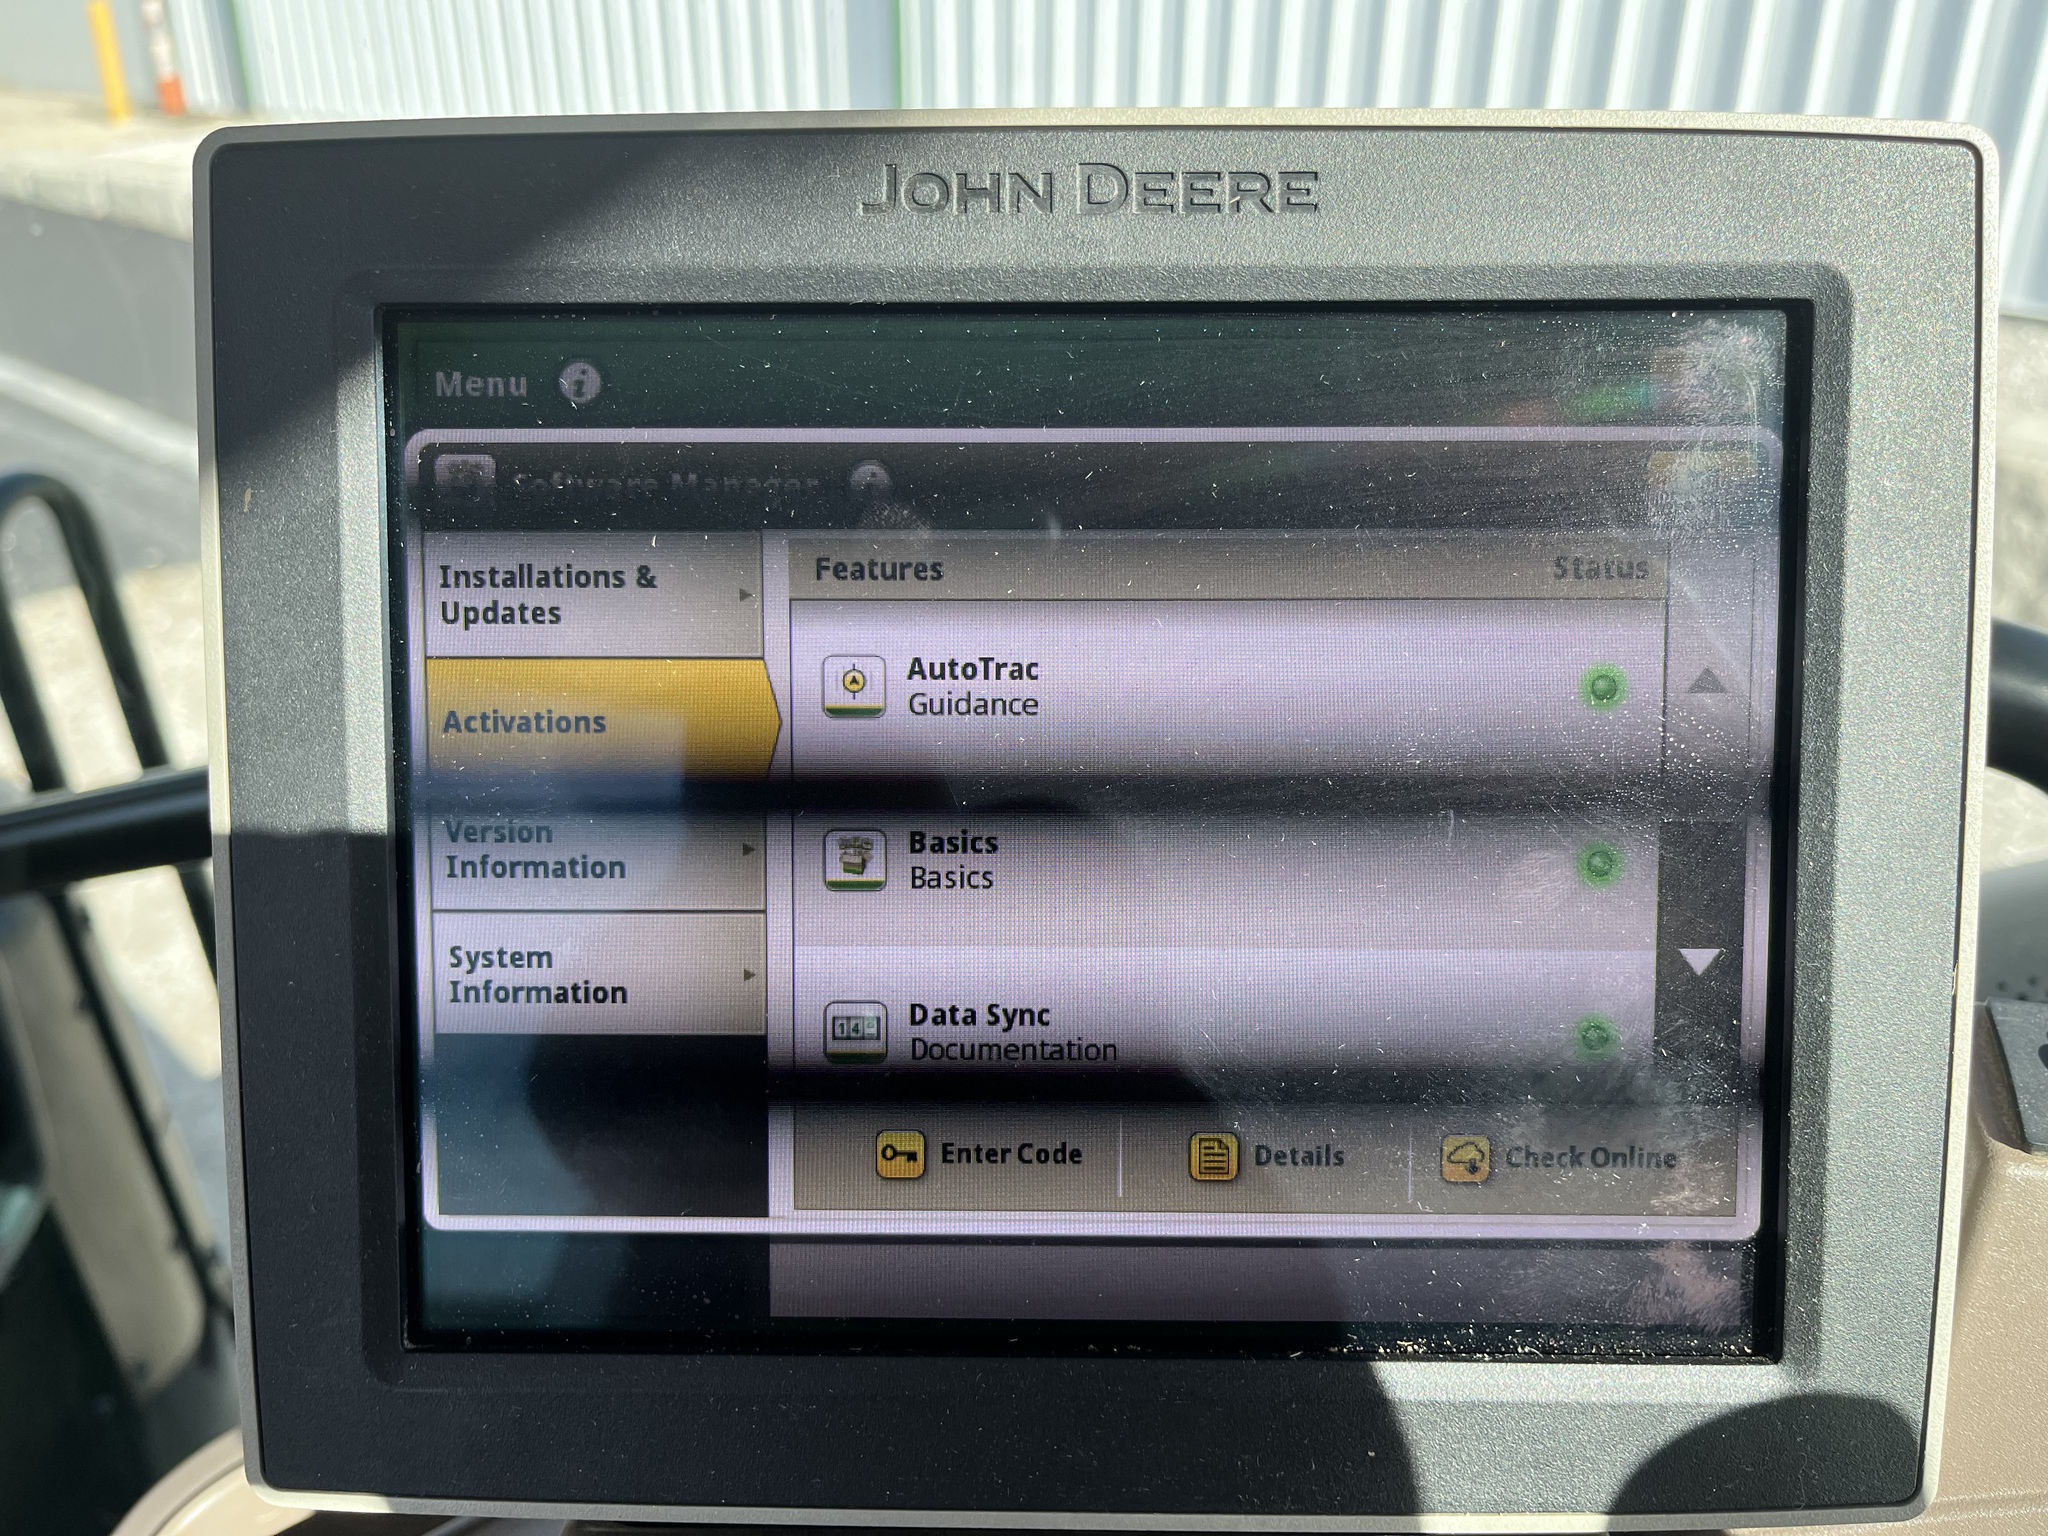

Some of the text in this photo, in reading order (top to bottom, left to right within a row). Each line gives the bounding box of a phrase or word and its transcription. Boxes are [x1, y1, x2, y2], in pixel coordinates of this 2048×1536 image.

[861, 162, 1319, 215] JOHN DEERE
[435, 371, 528, 398] Menu
[439, 564, 658, 590] Installations &
[815, 557, 945, 583] Features
[1554, 556, 1650, 582] Status
[440, 601, 562, 631] Updates
[907, 657, 1039, 681] AutoTrac
[909, 691, 1039, 716] Guidance
[443, 710, 607, 734] Activations
[446, 819, 554, 843] Version
[909, 830, 998, 855] Basics
[446, 855, 626, 879] Information
[911, 866, 994, 890] Basics
[450, 946, 553, 974] System
[450, 981, 628, 1004] Information
[909, 1002, 1051, 1032] Data Sync
[911, 1037, 1118, 1062] Documentation
[942, 1142, 1083, 1164] Enter Code
[1255, 1144, 1344, 1168] Details
[1505, 1145, 1678, 1169] Check Online
